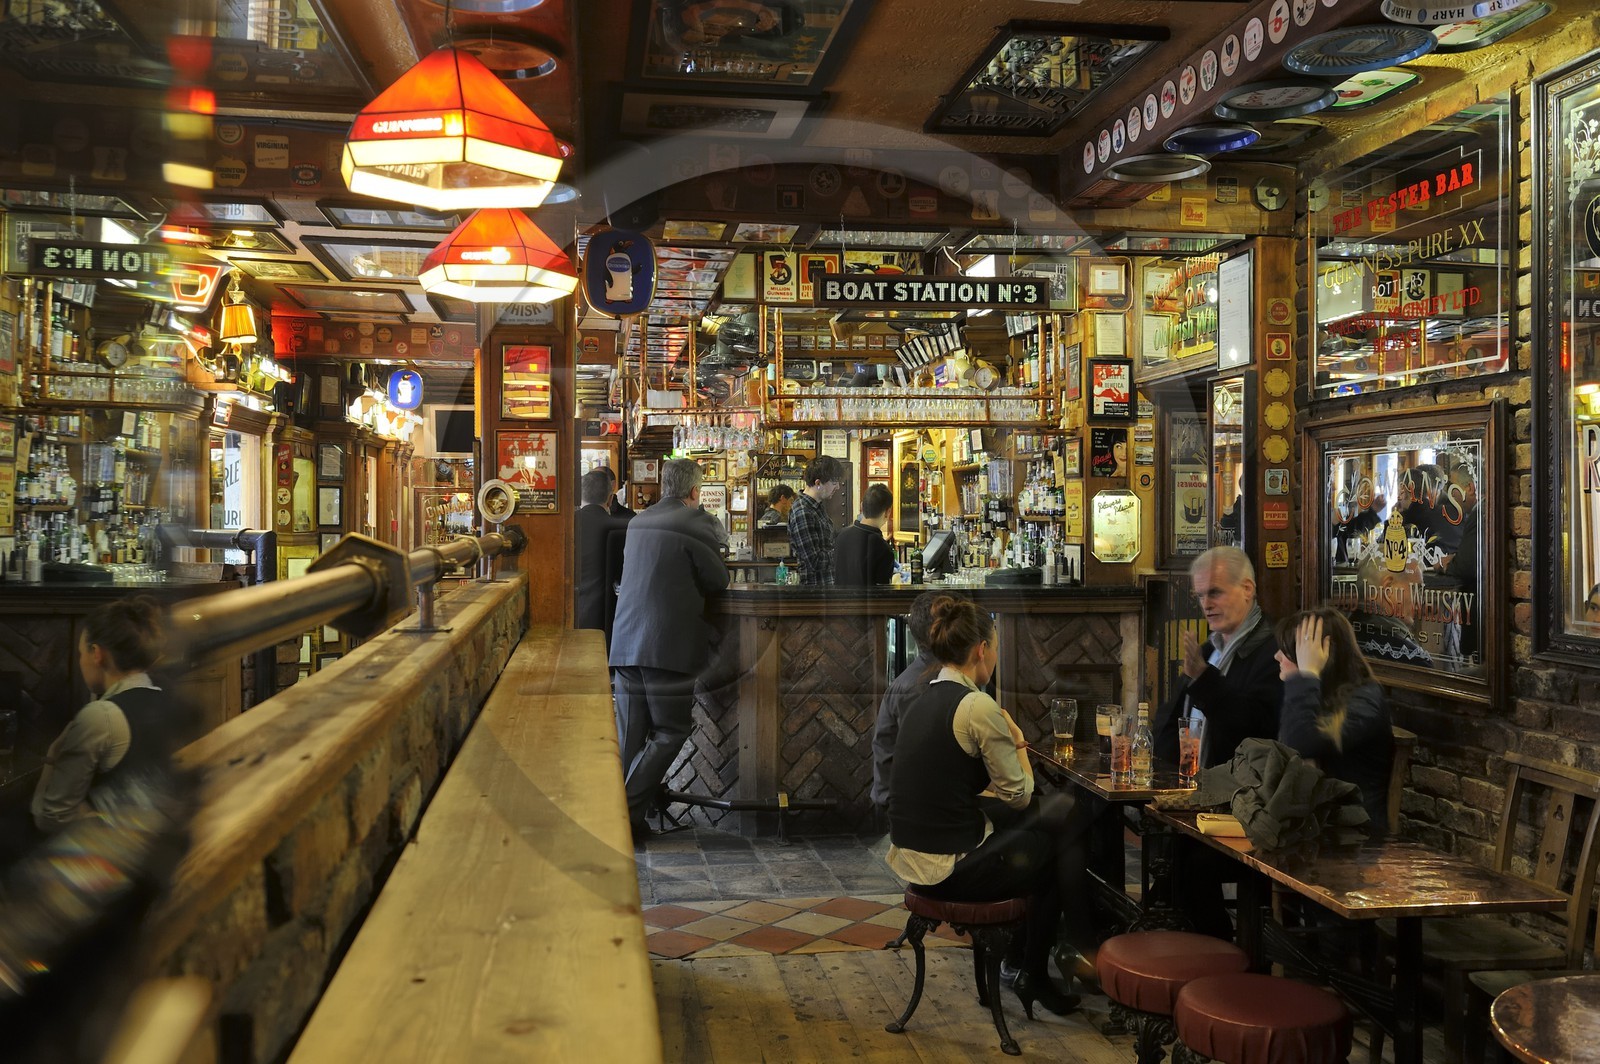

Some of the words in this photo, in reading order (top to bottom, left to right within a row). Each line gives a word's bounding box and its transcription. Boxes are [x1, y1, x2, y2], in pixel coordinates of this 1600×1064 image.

[1391, 6, 1412, 19] HARP
[1432, 9, 1465, 20] HARP
[373, 117, 443, 133] GUINNESS
[1332, 206, 1363, 235] THE
[1367, 179, 1431, 222] ULSTER
[1435, 162, 1474, 197] BAR
[1408, 228, 1453, 263] PURE
[1458, 217, 1485, 249] XX
[826, 280, 888, 301] BOAT
[893, 282, 990, 303] STATION
[1372, 272, 1423, 299] BOTTLERS
[1093, 453, 1111, 466] Bass
[1583, 424, 1600, 494] R
[1331, 578, 1359, 611] OLD
[1363, 579, 1404, 619] IRISH
[1409, 583, 1475, 625] WHISKY
[1352, 621, 1443, 645] BELFAST
